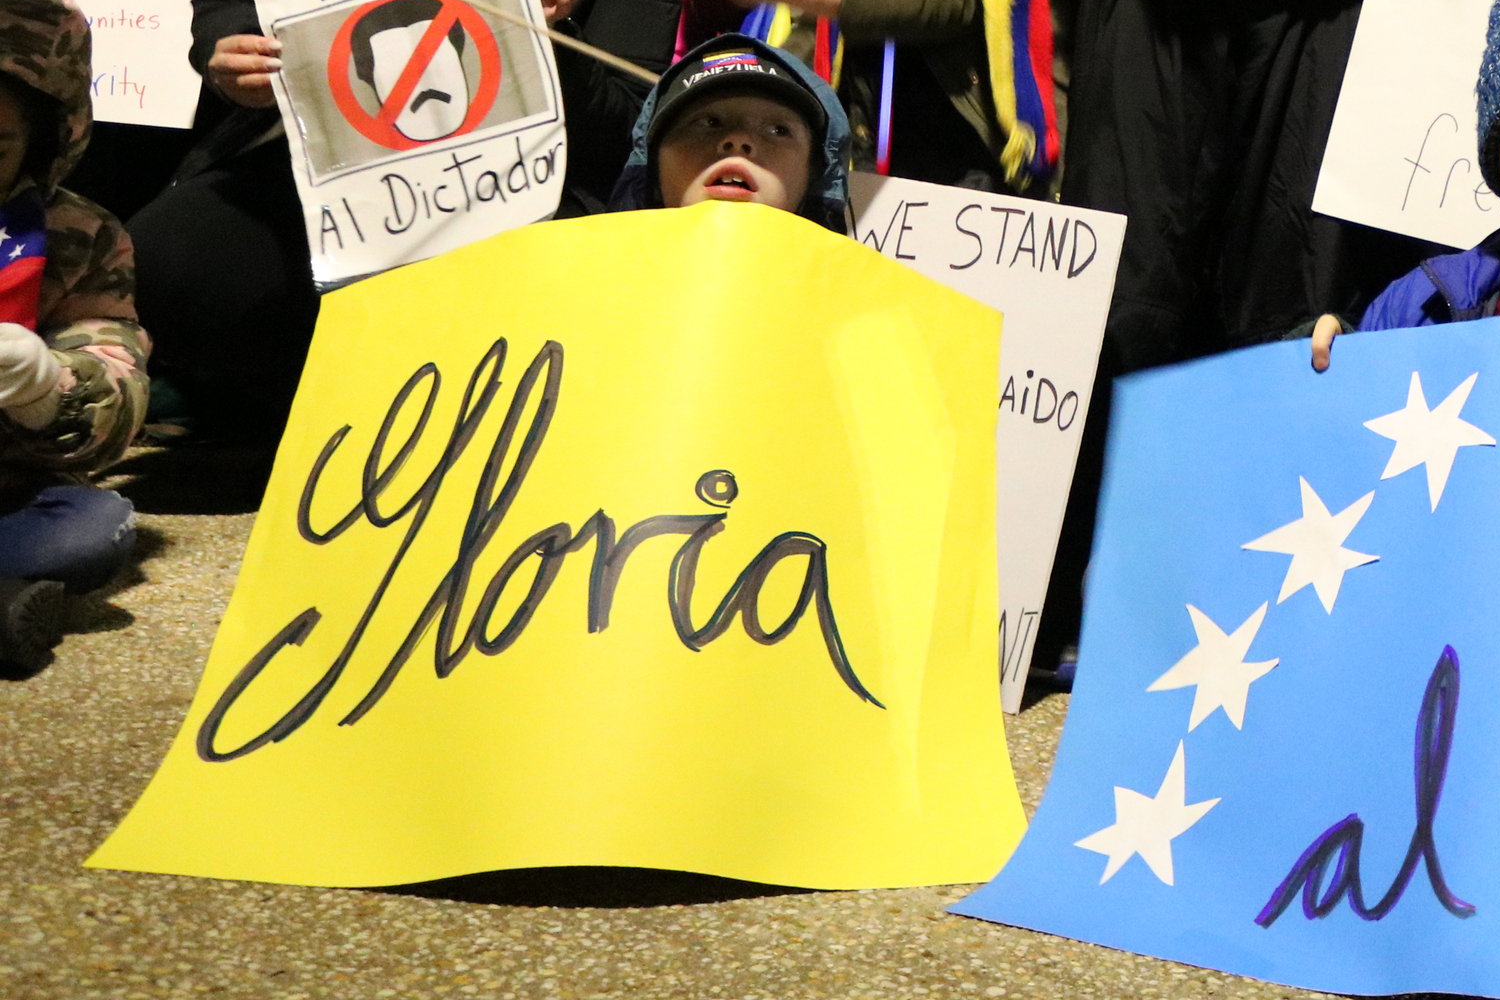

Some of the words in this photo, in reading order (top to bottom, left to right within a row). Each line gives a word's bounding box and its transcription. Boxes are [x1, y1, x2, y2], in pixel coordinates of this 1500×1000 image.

[91, 65, 146, 109] rity
[380, 136, 564, 235] Dictador
[848, 196, 929, 260] WE
[949, 203, 1097, 279] STAND
[197, 335, 886, 763] Gloria
[1254, 643, 1477, 929] al
